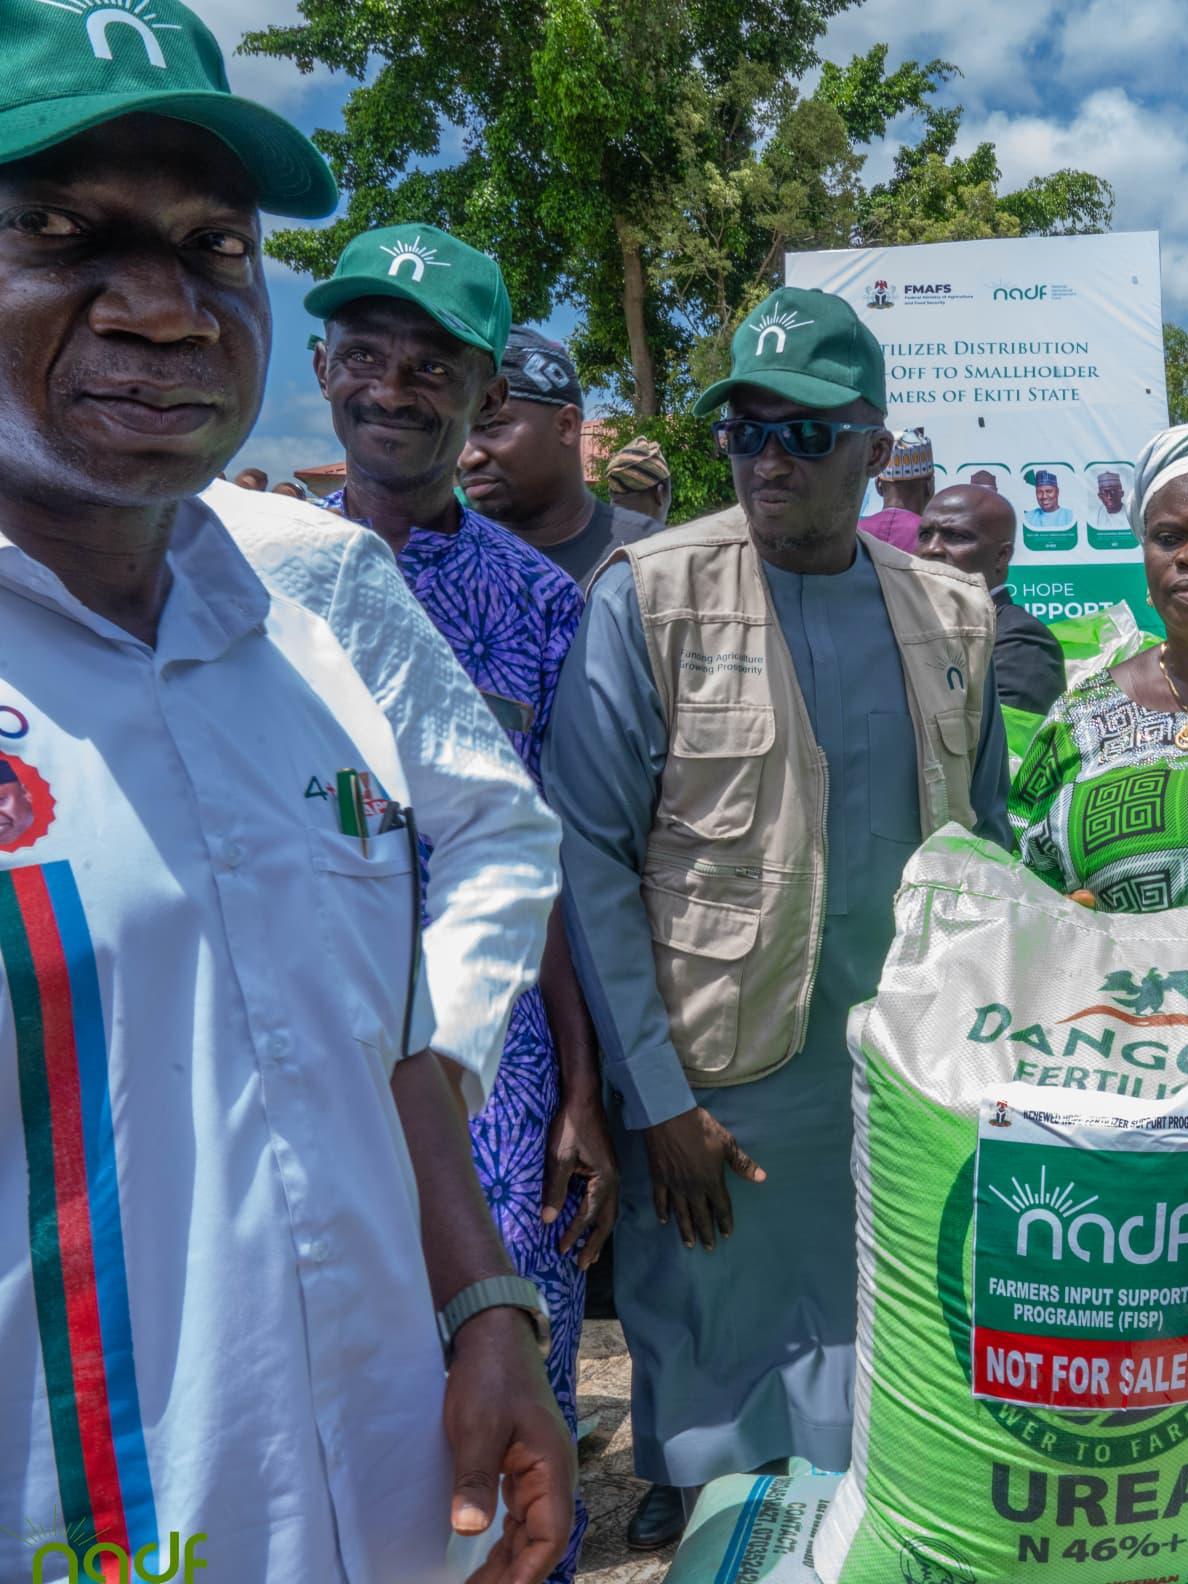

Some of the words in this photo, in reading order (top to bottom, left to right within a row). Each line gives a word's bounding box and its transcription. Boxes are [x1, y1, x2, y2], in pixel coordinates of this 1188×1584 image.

[904, 284, 952, 294] FMAFS
[954, 341, 1089, 355] DISTRIBUTION
[932, 366, 958, 379] TO
[964, 364, 1100, 379] SMALLHOLDER
[942, 389, 967, 402] OF
[974, 388, 1020, 402] EKITI
[1028, 387, 1080, 402] STATE
[1023, 583, 1075, 597] HOPE
[989, 1278, 1060, 1303] FARMERS
[1065, 1286, 1114, 1306] INPUT
[1013, 1304, 1114, 1328] PROGRAMME
[1118, 1311, 1164, 1332] (FISP)
[986, 1346, 1043, 1390] NOT
[1052, 1355, 1110, 1395] FOR
[1119, 1353, 1188, 1395] SALE
[1076, 1444, 1111, 1463] TO
[774, 1502, 807, 1554] CONTACT:
[1017, 1534, 1050, 1563] N
[1062, 1532, 1187, 1564] 46%+
